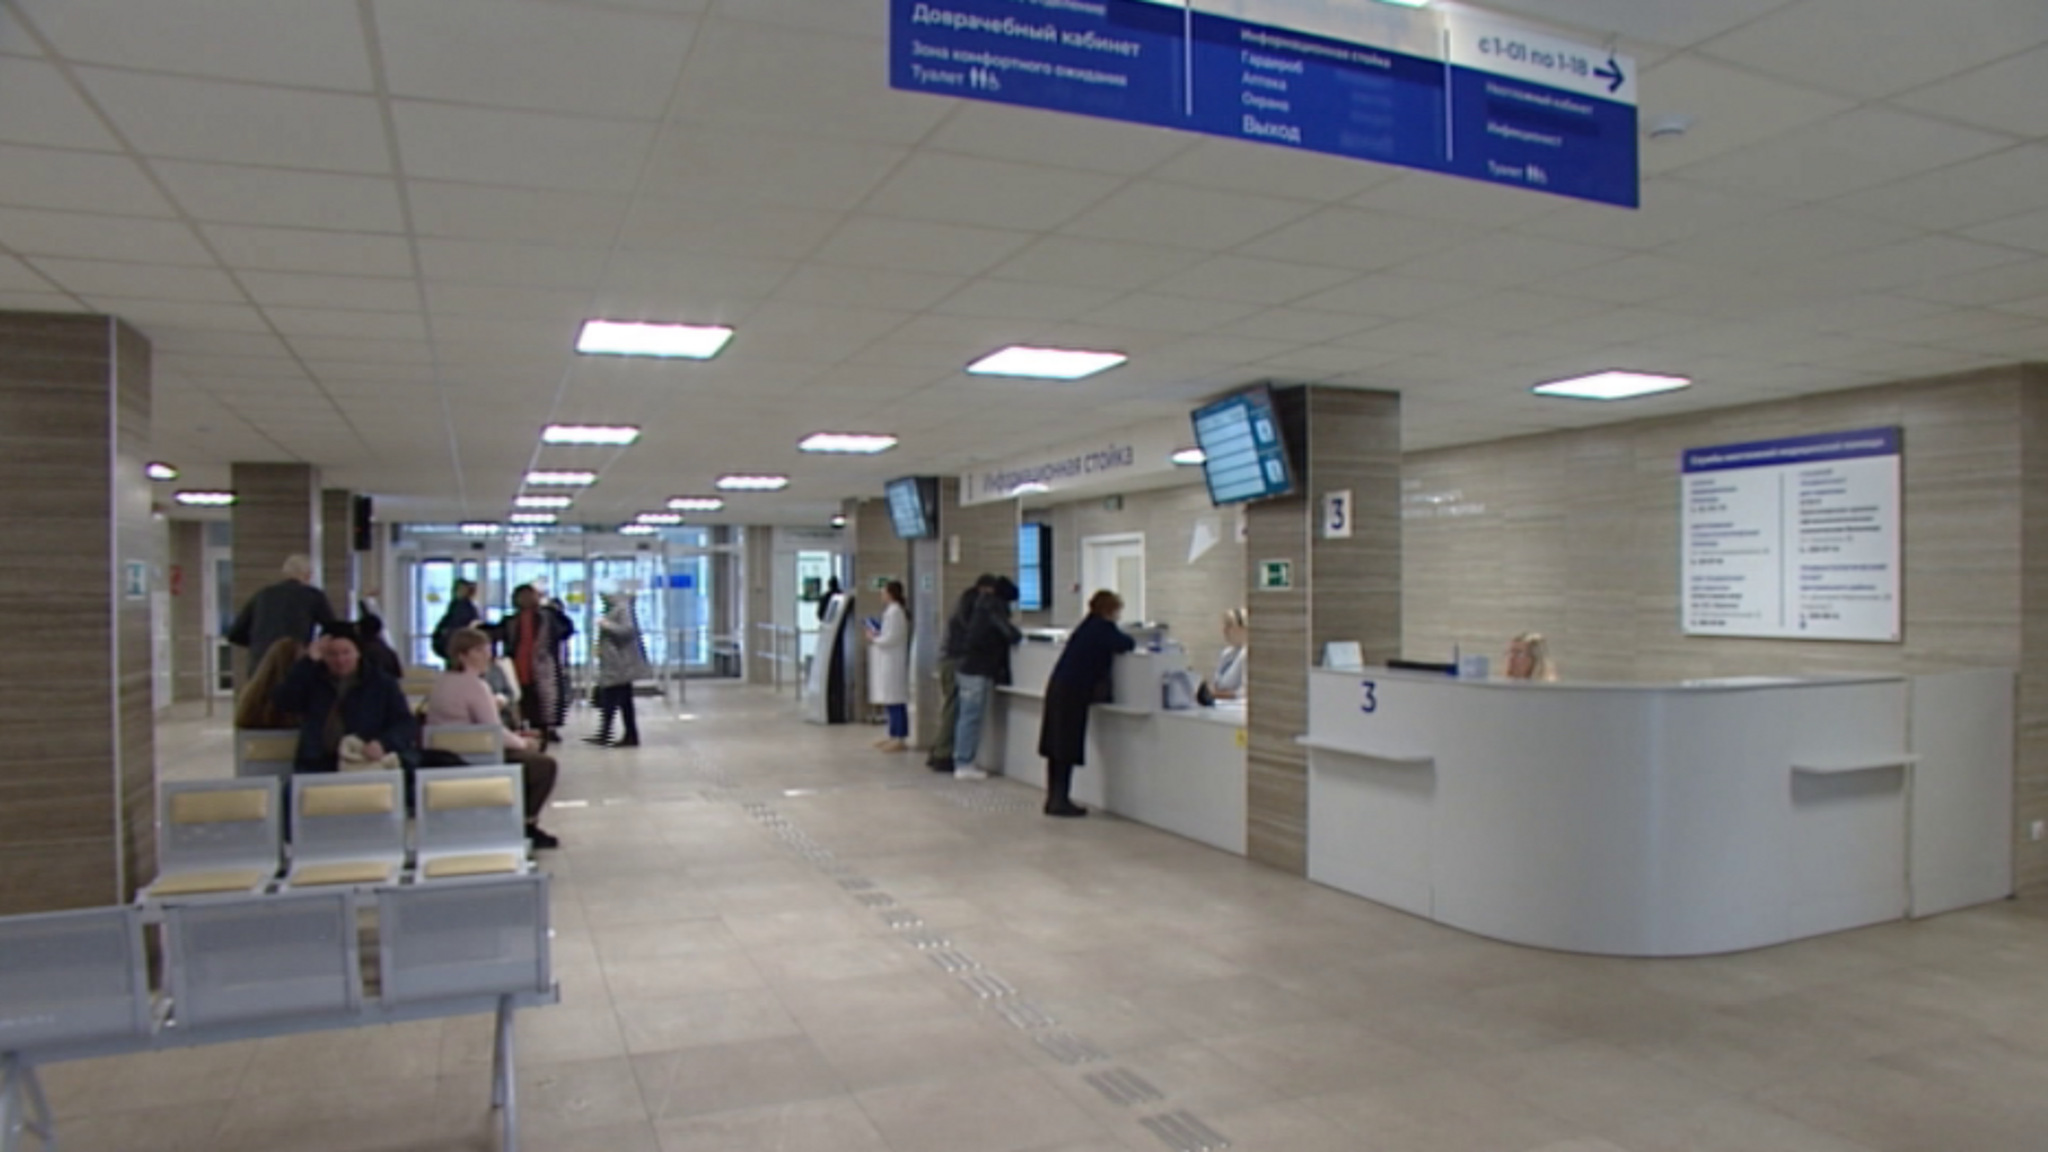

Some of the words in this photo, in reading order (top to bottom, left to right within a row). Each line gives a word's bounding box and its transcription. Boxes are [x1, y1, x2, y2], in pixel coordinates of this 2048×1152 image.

[912, 3, 1058, 42] Доврачебный
[1062, 30, 1140, 57] кабинет
[911, 63, 964, 85] Туалет
[912, 40, 949, 60] Зона
[952, 50, 1052, 76] комфортного
[1055, 64, 1127, 87] ожидания
[1241, 50, 1304, 75] Гардероб
[1531, 50, 1555, 69] по
[1241, 71, 1287, 91] Аптека
[1241, 91, 1290, 112] Охрана
[1243, 114, 1301, 144] Выход
[1083, 444, 1133, 474] стойка
[1330, 497, 1345, 531] 3
[1360, 681, 1377, 713] 3
